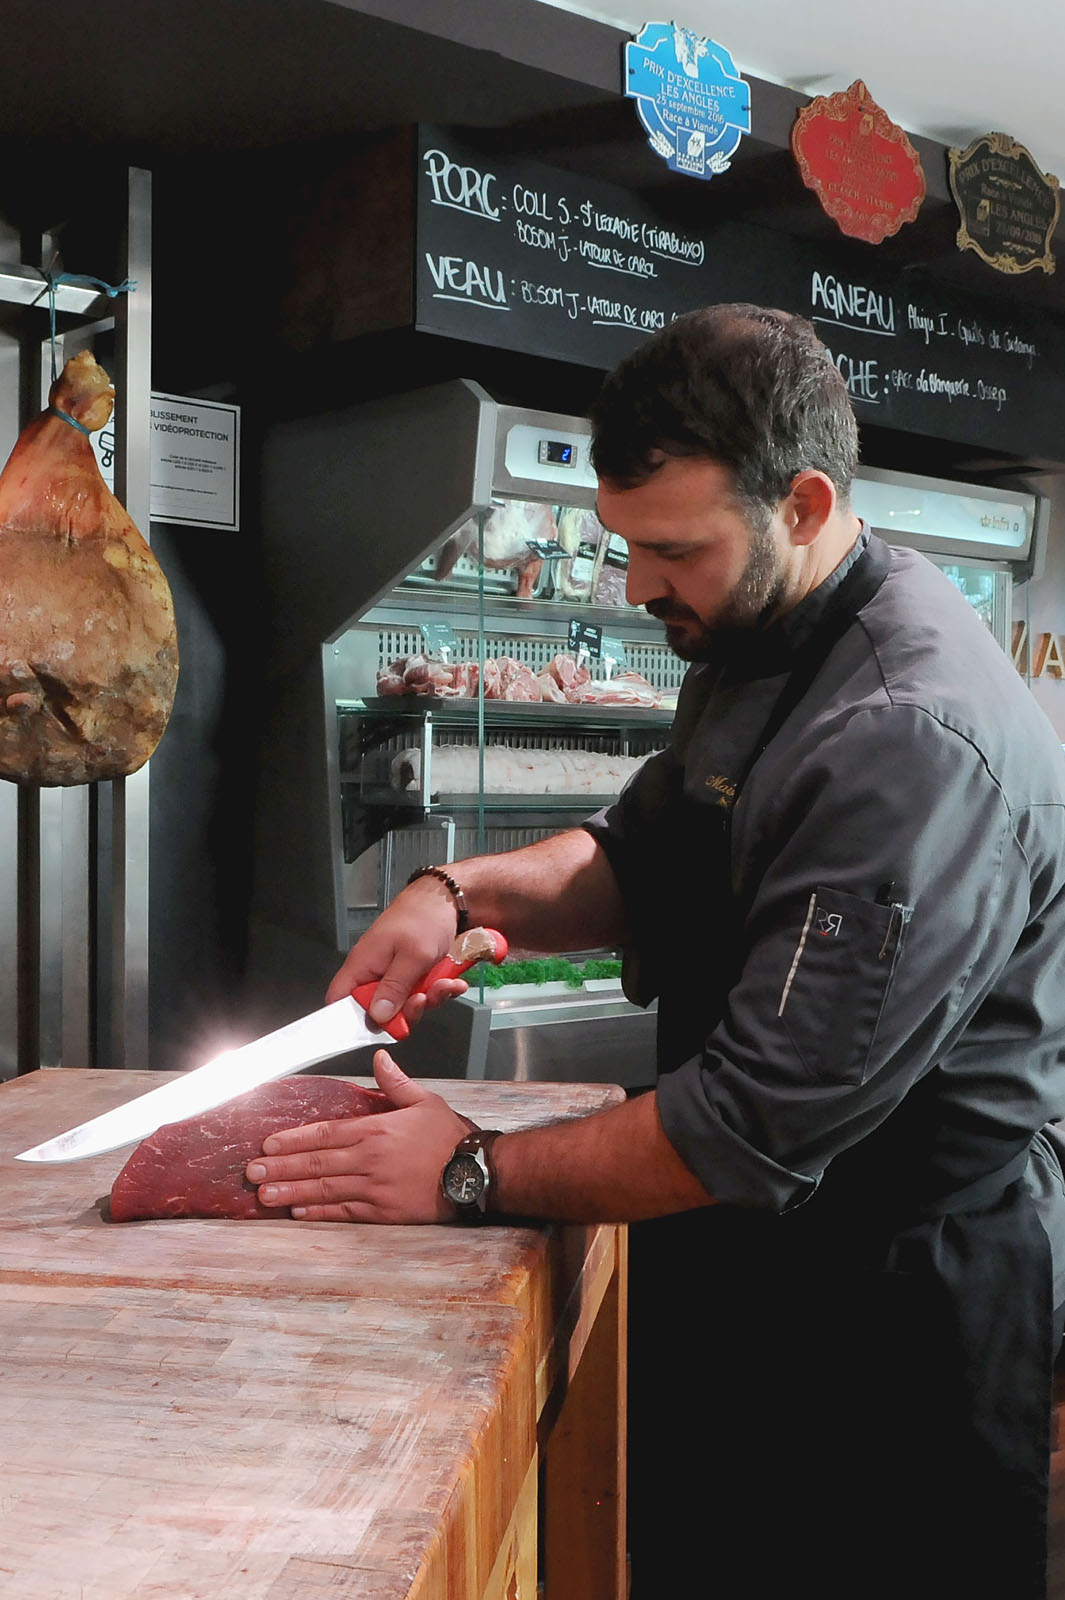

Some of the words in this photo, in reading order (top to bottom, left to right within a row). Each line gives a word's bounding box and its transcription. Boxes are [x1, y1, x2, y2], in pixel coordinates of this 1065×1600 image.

[643, 57, 665, 78] PRIX
[667, 71, 736, 98] D'EXCELLENCE
[661, 83, 679, 99] LES
[681, 91, 720, 112] ANGLES
[668, 100, 706, 118] septembre
[707, 110, 724, 124] 2016
[662, 108, 683, 125] Race
[691, 119, 719, 136] Viande
[513, 184, 553, 220] COLL
[990, 201, 1010, 217] LES
[579, 239, 613, 264] LATOUR
[612, 249, 626, 268] DE
[587, 295, 622, 320] LATOUR
[623, 304, 638, 326] DE
[811, 270, 895, 332] AGNEAU
[154, 423, 228, 441] VIDÉOPROTECTION
[561, 448, 570, 461] 2
